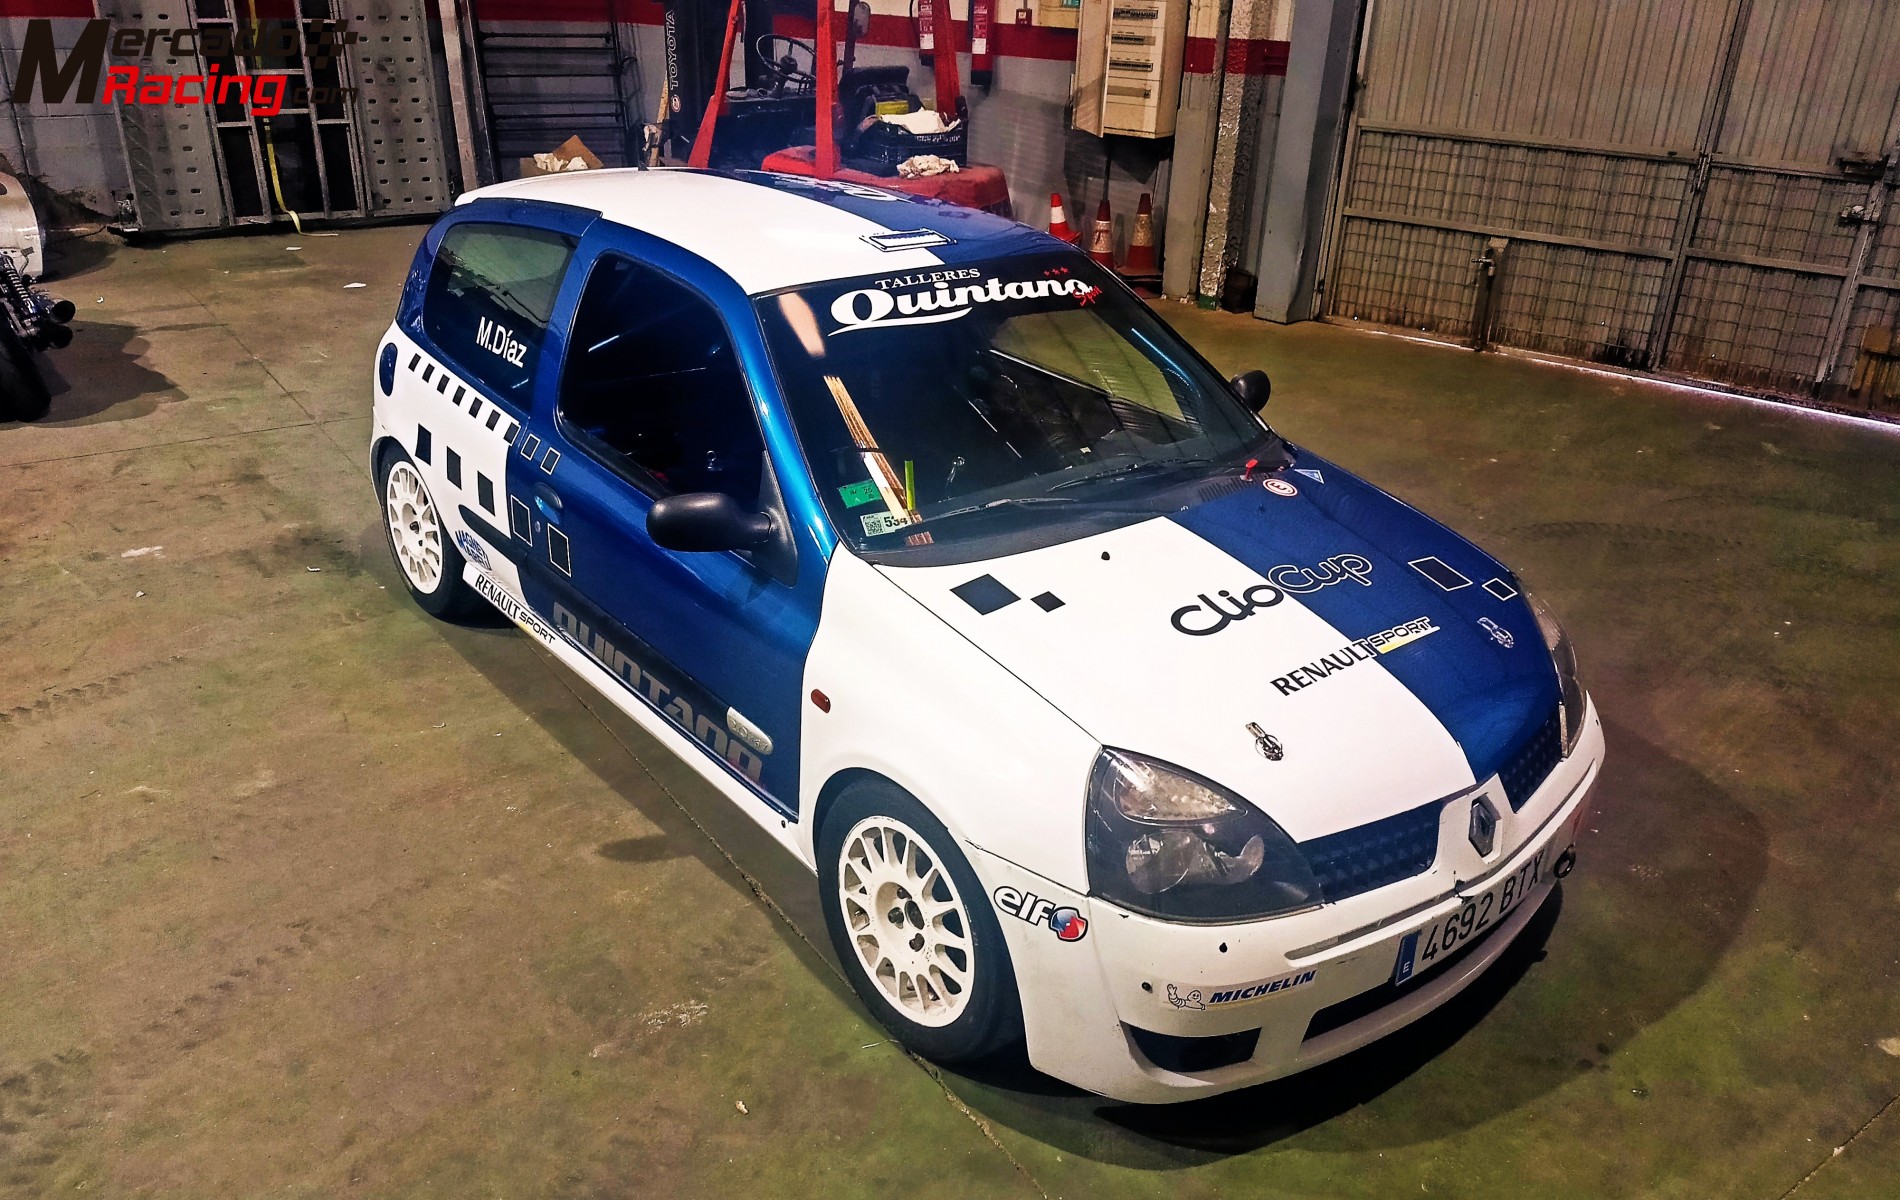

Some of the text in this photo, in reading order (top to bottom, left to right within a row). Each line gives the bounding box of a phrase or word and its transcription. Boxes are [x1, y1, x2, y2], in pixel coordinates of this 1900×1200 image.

[665, 9, 678, 90] TOYOTA
[875, 268, 981, 291] TALLERES
[827, 278, 1094, 337] Quintano
[476, 316, 527, 368] M.Díaz
[475, 574, 556, 643] RENAULT SPORT
[1270, 616, 1432, 697] RENAULT SPORT
[992, 886, 1055, 926] elf
[1421, 849, 1545, 961] 4692 BTX
[1208, 969, 1317, 1004] MICHELIN
[1402, 960, 1411, 974] E
